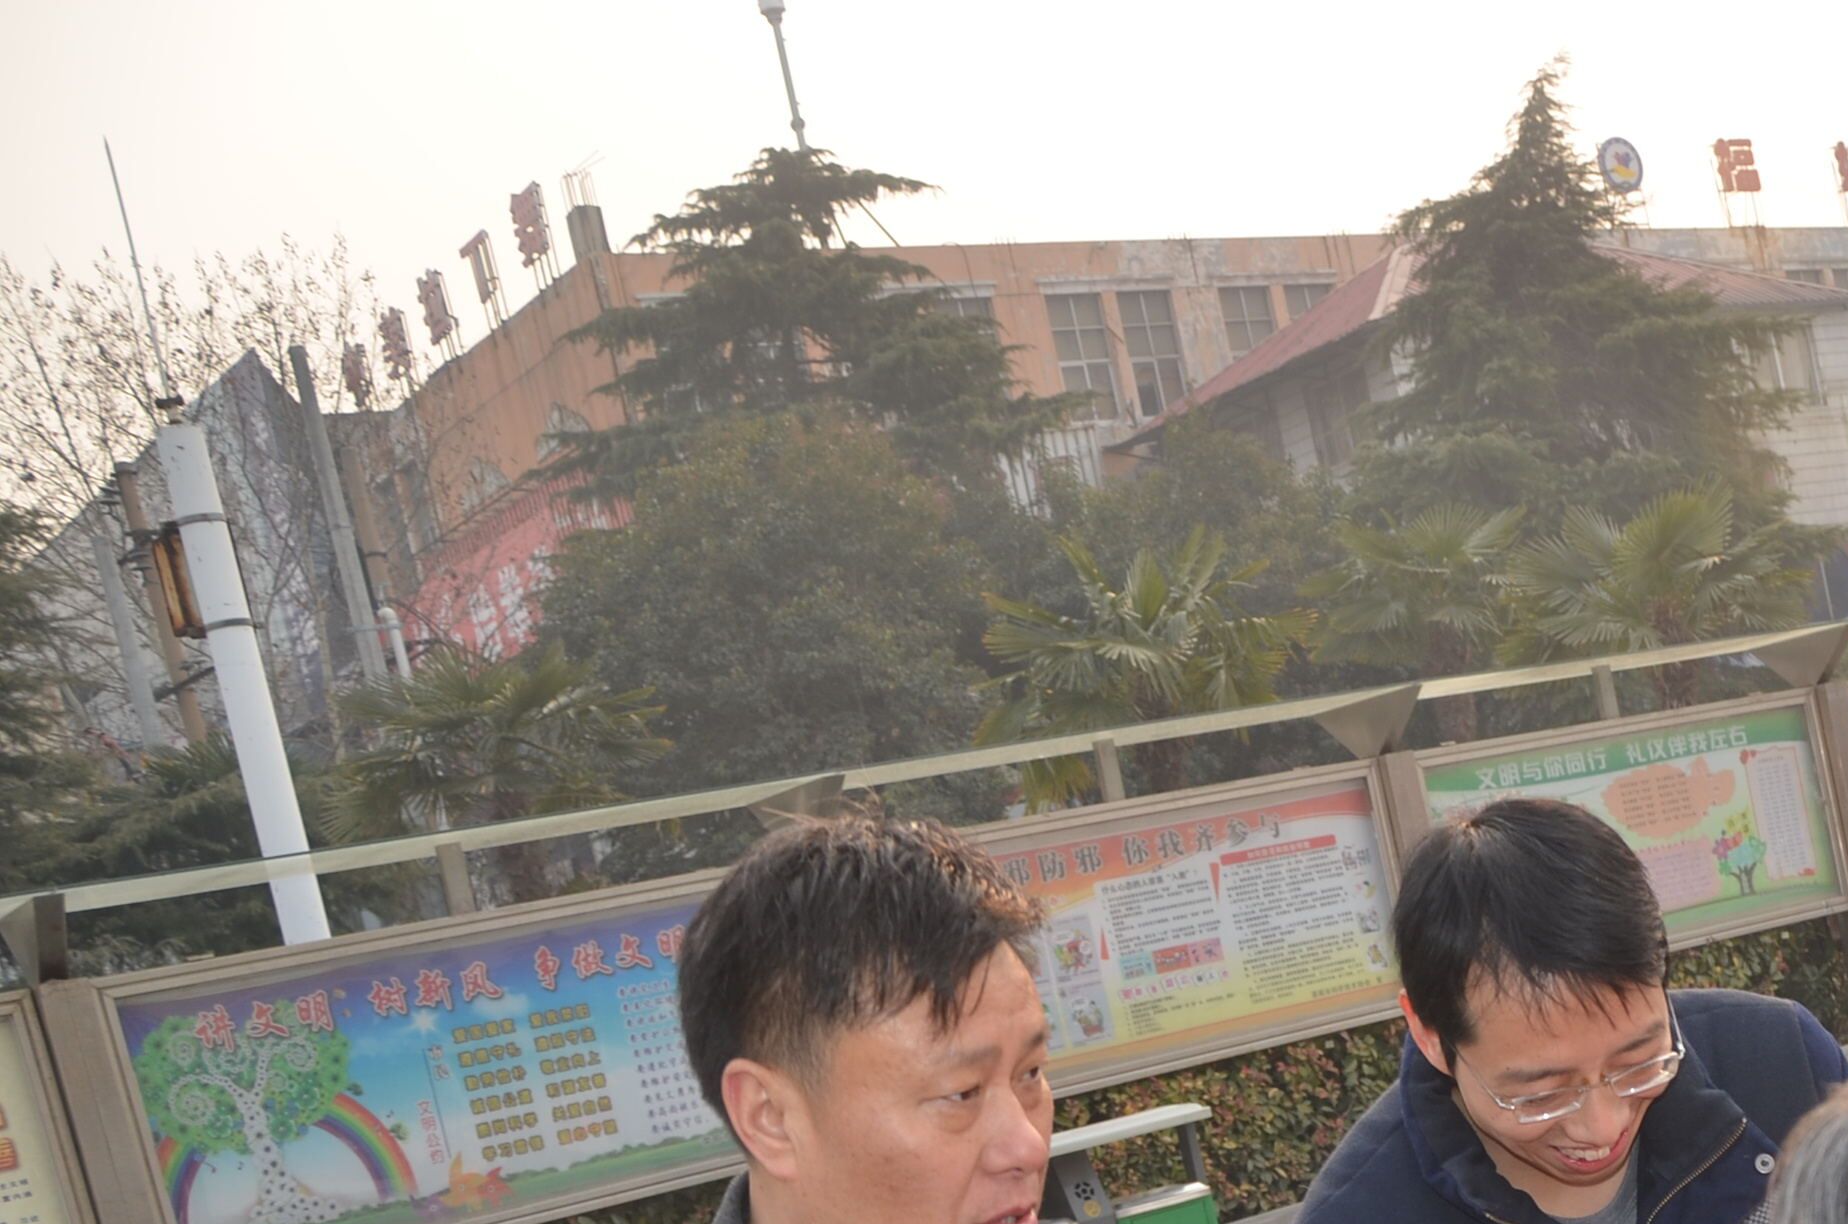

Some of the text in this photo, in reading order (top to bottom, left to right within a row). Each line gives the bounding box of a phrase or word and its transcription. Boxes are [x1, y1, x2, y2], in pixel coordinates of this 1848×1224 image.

[1475, 724, 1749, 791] 文明与你同行 礼仪伴我左右
